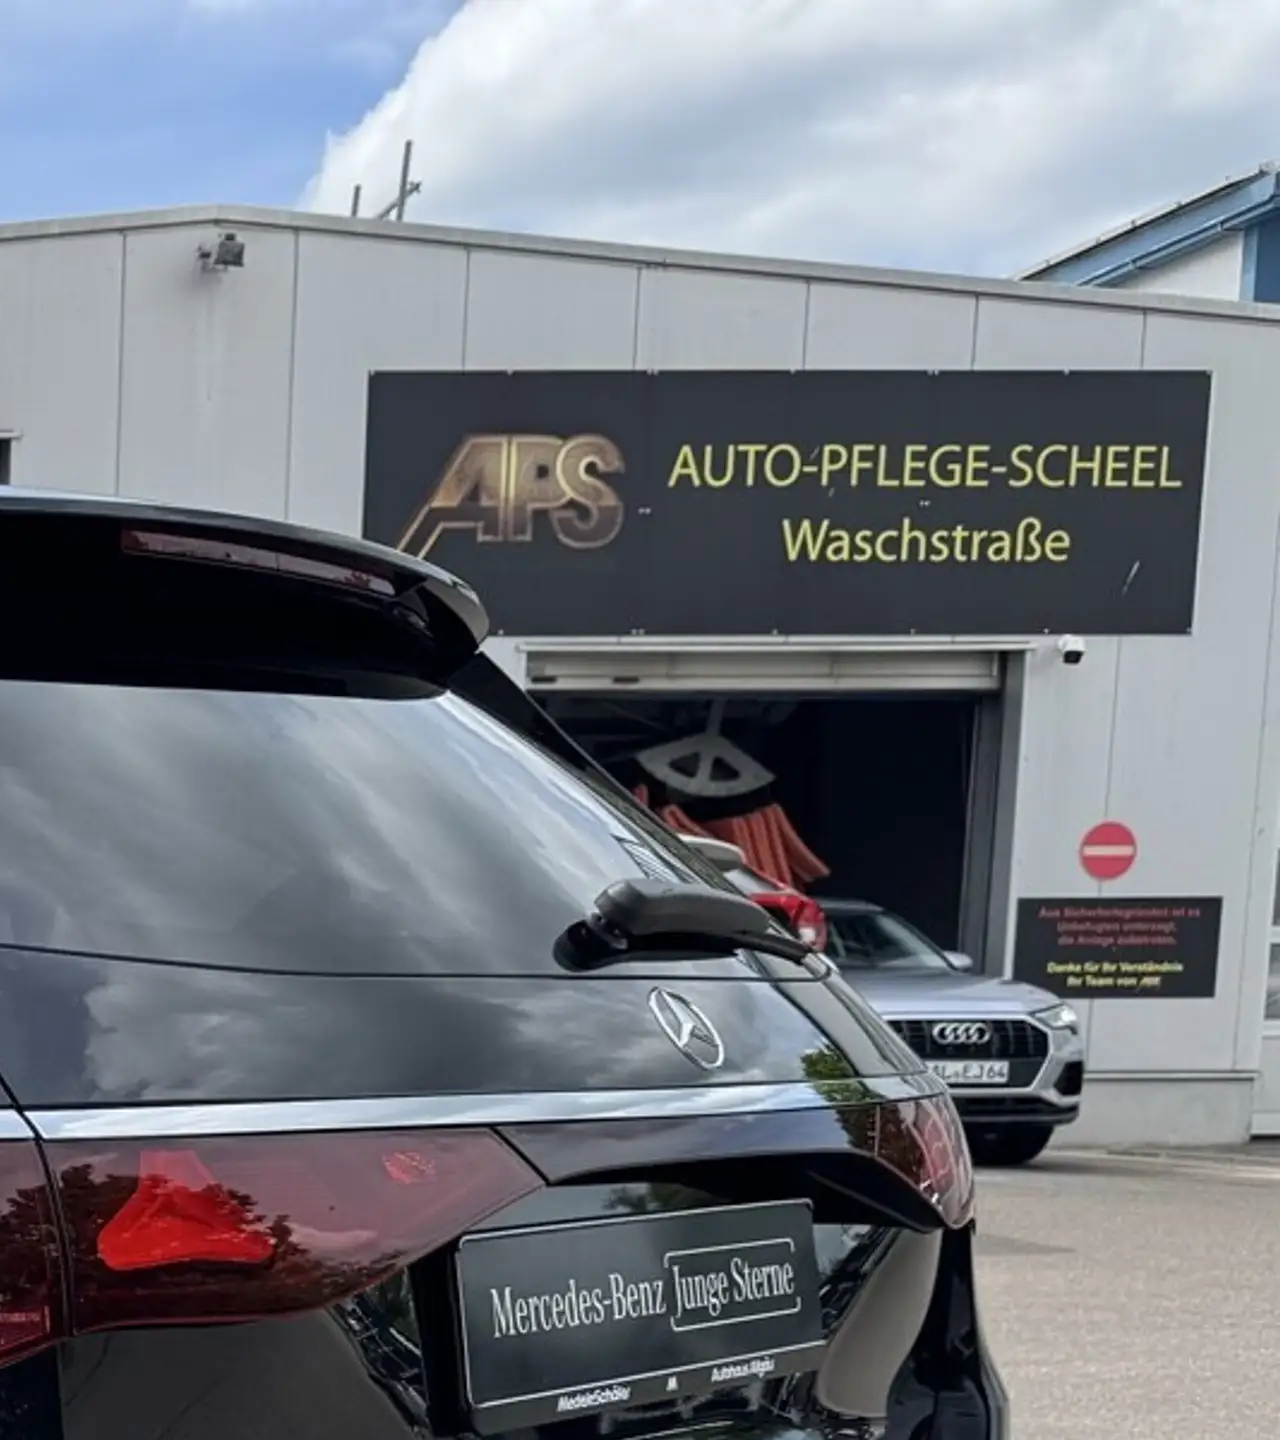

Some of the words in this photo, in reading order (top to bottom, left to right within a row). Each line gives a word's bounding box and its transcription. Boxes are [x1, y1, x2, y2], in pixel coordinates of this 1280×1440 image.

[397, 433, 626, 558] APS
[667, 443, 1183, 489] AUTO-PFLEGE-SCHEEL
[781, 516, 1071, 564] Waschstraße
[490, 1272, 667, 1339] Mercedes-Benz
[672, 1264, 730, 1319] Junge
[730, 1256, 795, 1303] Sterne
